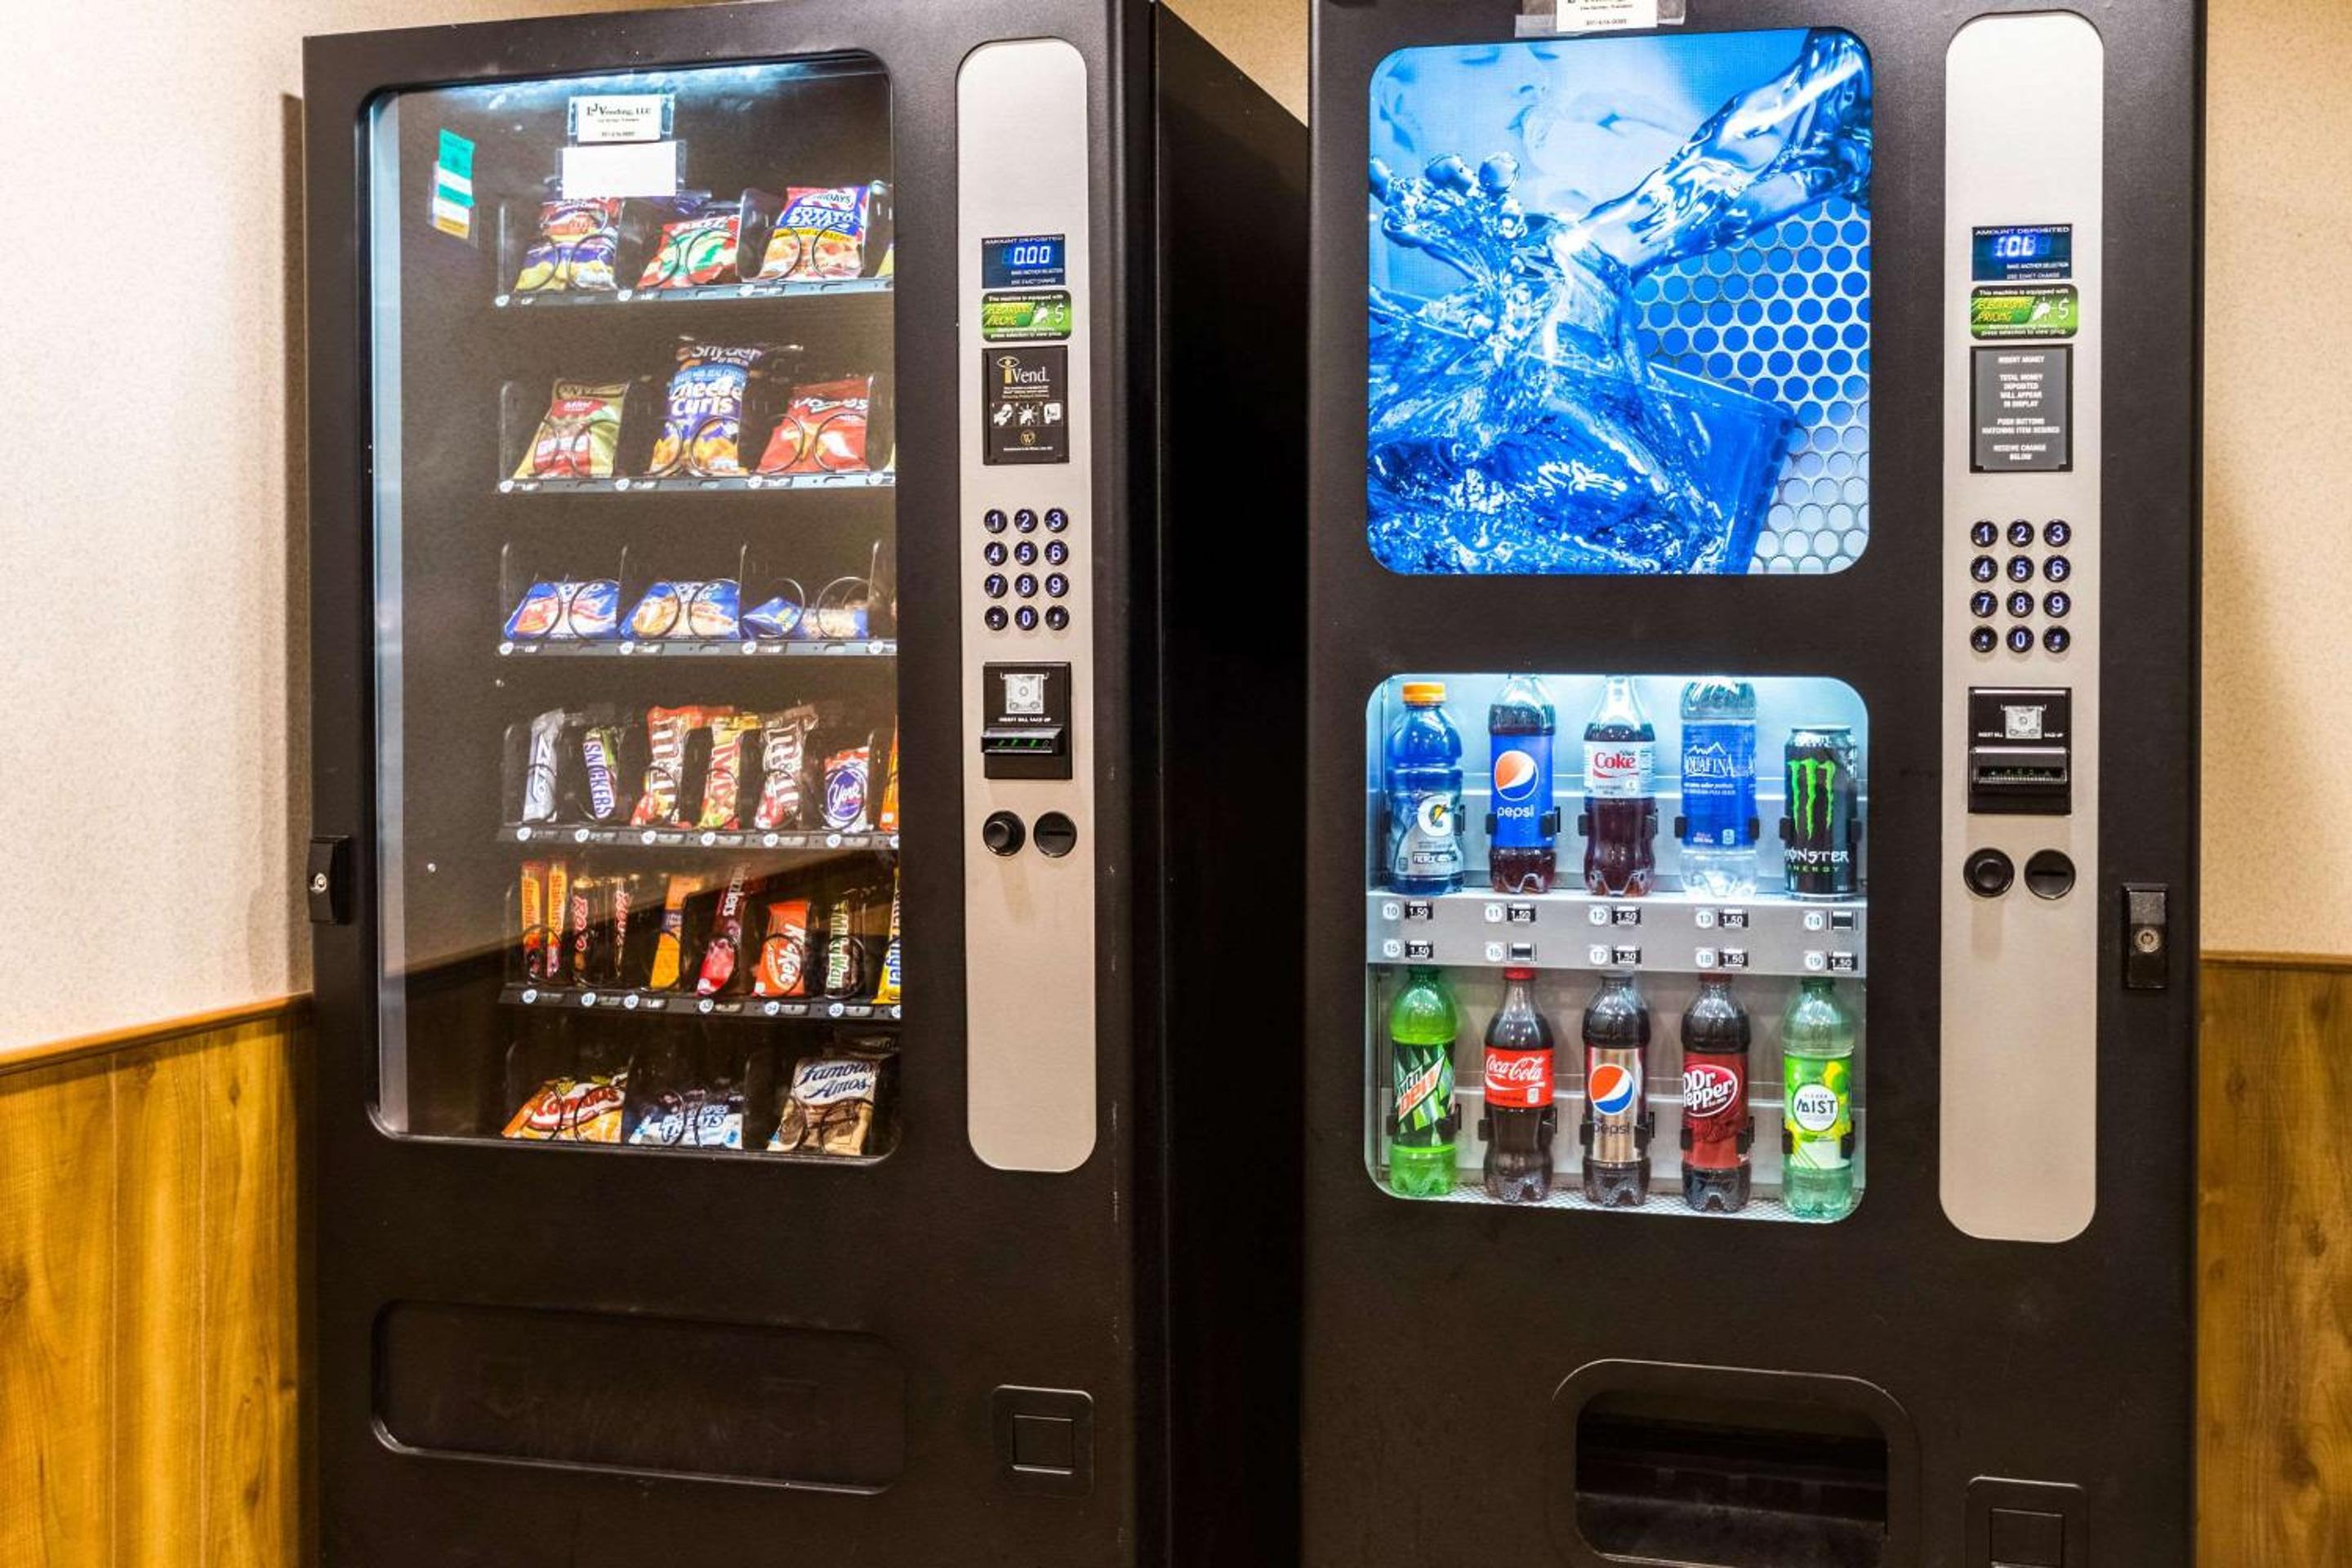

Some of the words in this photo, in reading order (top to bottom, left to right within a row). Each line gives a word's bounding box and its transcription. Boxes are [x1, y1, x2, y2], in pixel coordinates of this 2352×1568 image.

[991, 514, 999, 528] 1
[1022, 513, 1029, 528] 2
[1052, 512, 1061, 528] 3
[1980, 525, 1989, 541] 1
[2016, 526, 2026, 541] 2
[2051, 525, 2064, 541] 3
[991, 547, 999, 561] 4
[1022, 546, 1030, 560] 5
[1052, 546, 1061, 560] 6
[1979, 561, 1989, 577] 4
[2016, 561, 2026, 577] 5
[2051, 561, 2063, 577] 6
[991, 578, 999, 593] 7
[1022, 578, 1031, 593] 8
[1052, 578, 1061, 593] 9
[1980, 596, 1989, 612] 7
[2016, 596, 2025, 612] 8
[2051, 596, 2063, 612] 9
[1022, 611, 1031, 626] 0
[2016, 631, 2025, 648] 0
[1594, 752, 1636, 768] Coke
[584, 743, 613, 818] SNICKERS
[1497, 805, 1535, 820] pepsi
[1410, 907, 1429, 916] 1.50
[1593, 911, 1605, 920] 12
[1616, 912, 1637, 921] 1.50
[1722, 915, 1743, 924] 1.50
[1410, 947, 1429, 955] 1.50
[1616, 952, 1637, 961] 1.50
[1724, 954, 1744, 964] 1.50
[1831, 958, 1852, 967] 1.50
[1486, 1054, 1545, 1081] Coca-Cola
[804, 1077, 871, 1098] Amos
[1690, 1070, 1717, 1090] Dr
[1797, 1098, 1836, 1114] MIST
